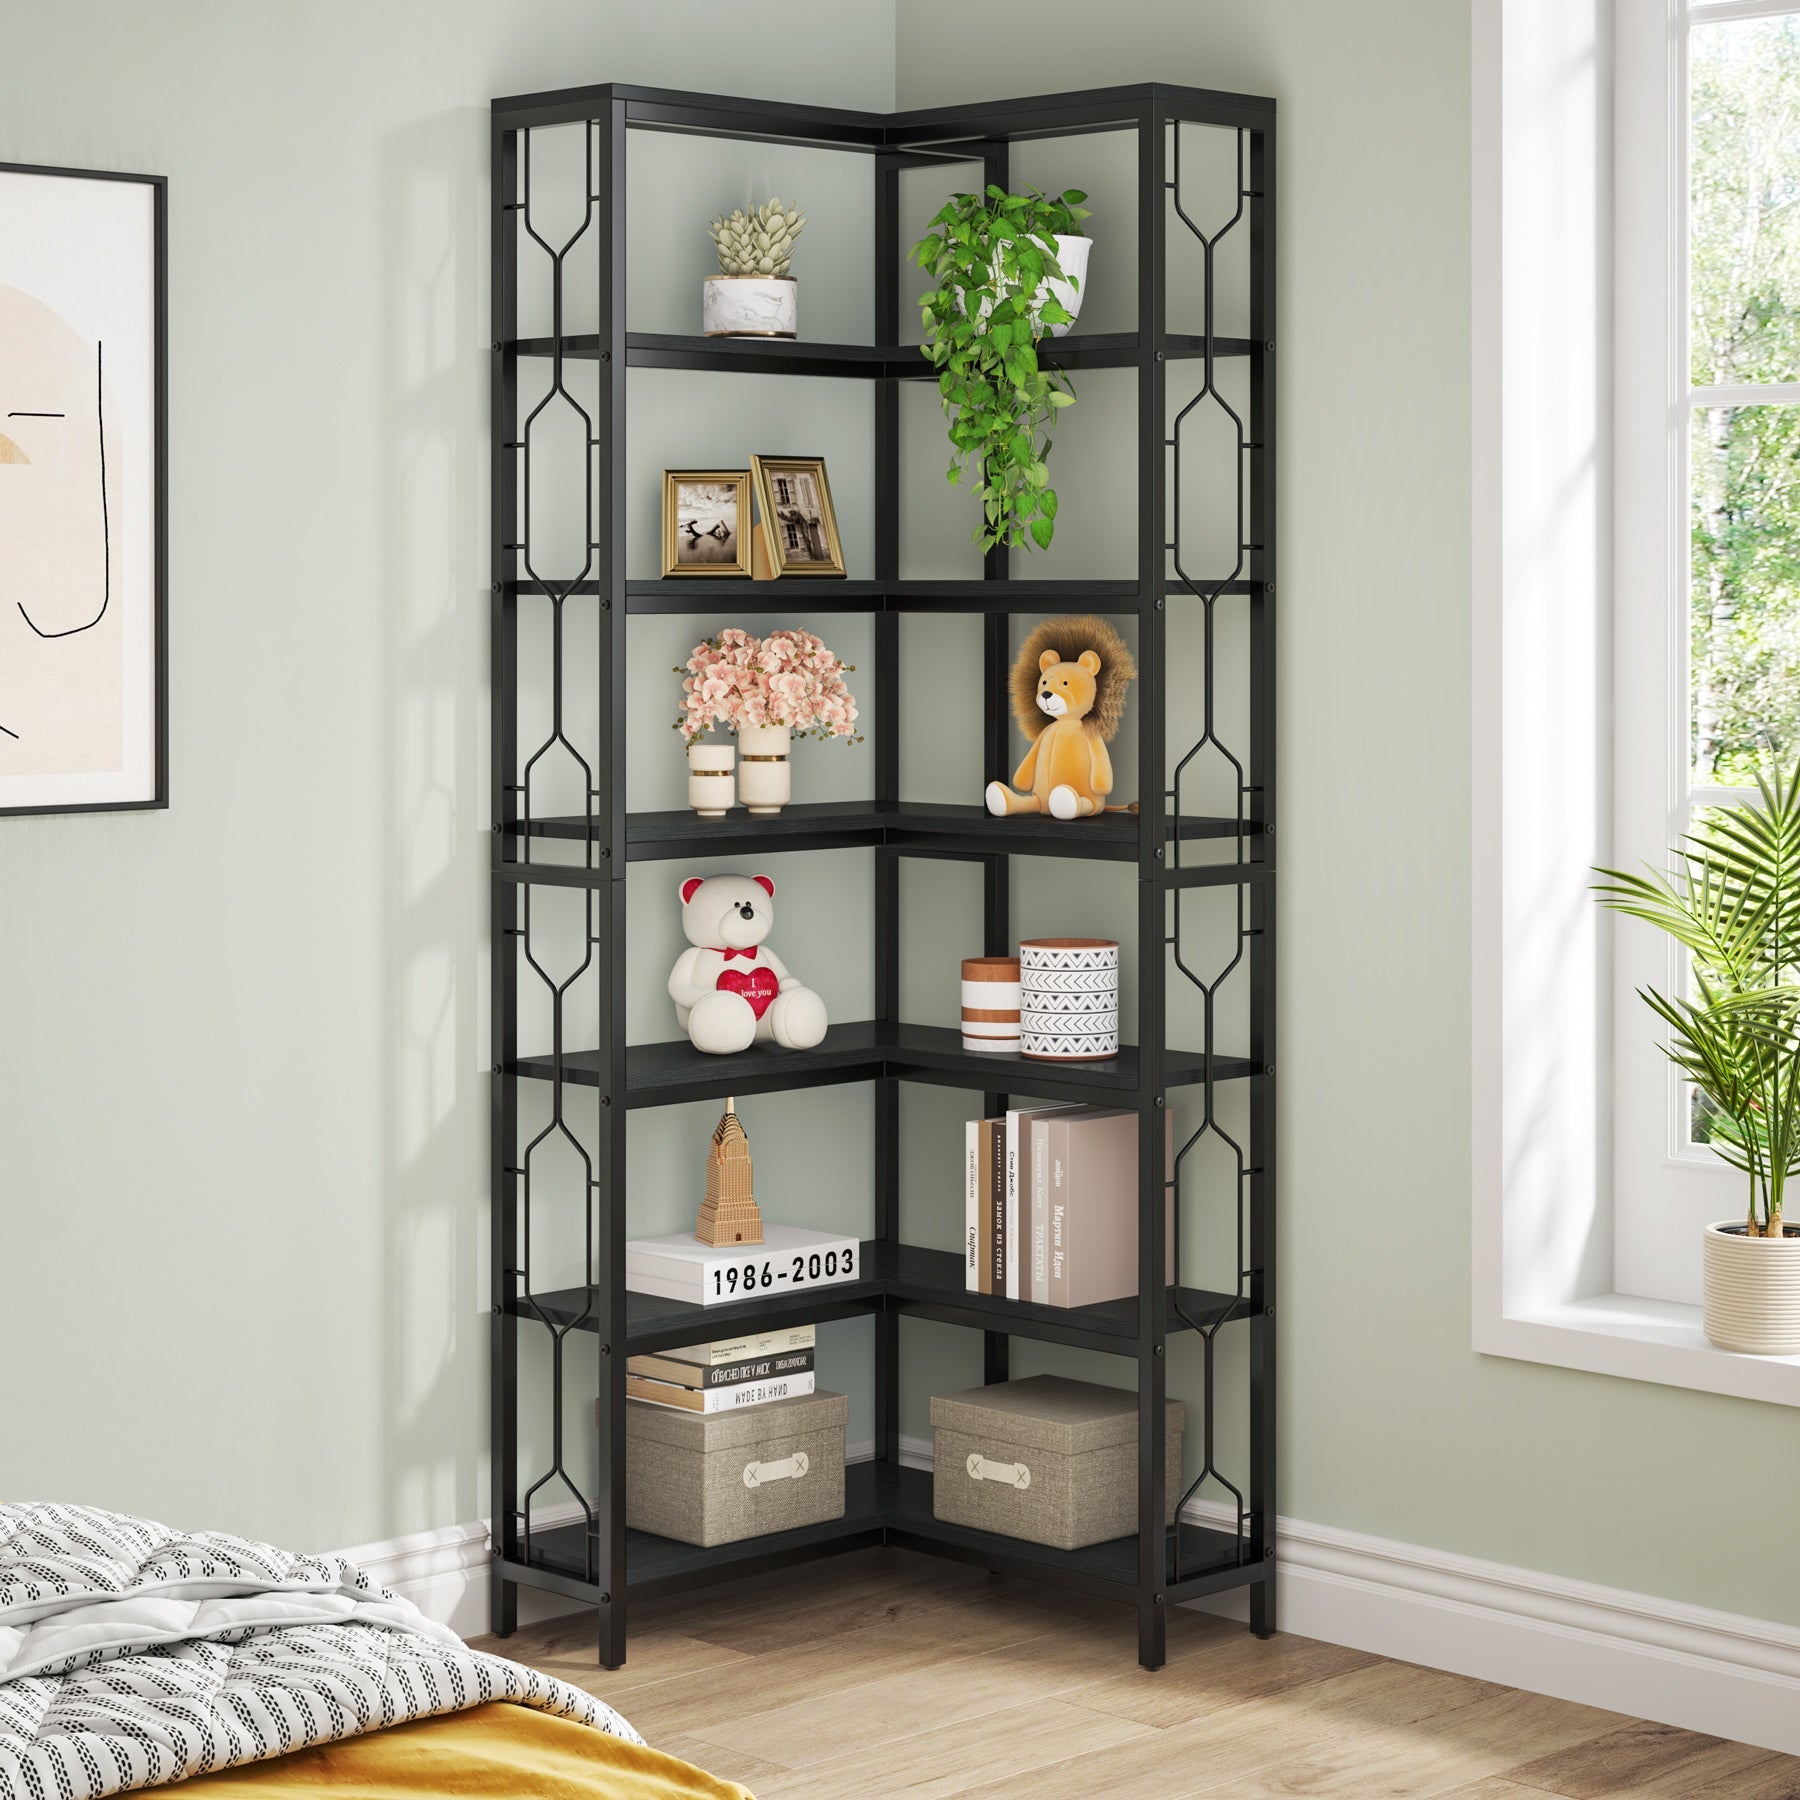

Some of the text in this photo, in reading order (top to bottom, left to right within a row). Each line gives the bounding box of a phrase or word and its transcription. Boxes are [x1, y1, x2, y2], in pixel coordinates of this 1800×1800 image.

[741, 989, 772, 999] love you
[751, 978, 755, 988] I
[996, 1234, 1003, 1245] из
[1052, 1205, 1064, 1246] Мартин
[967, 1226, 977, 1269] Спартак
[1035, 1224, 1044, 1282] ТРАКТАТЫ
[714, 1249, 853, 1295] 1986-2003
[1053, 1251, 1064, 1279] Иден
